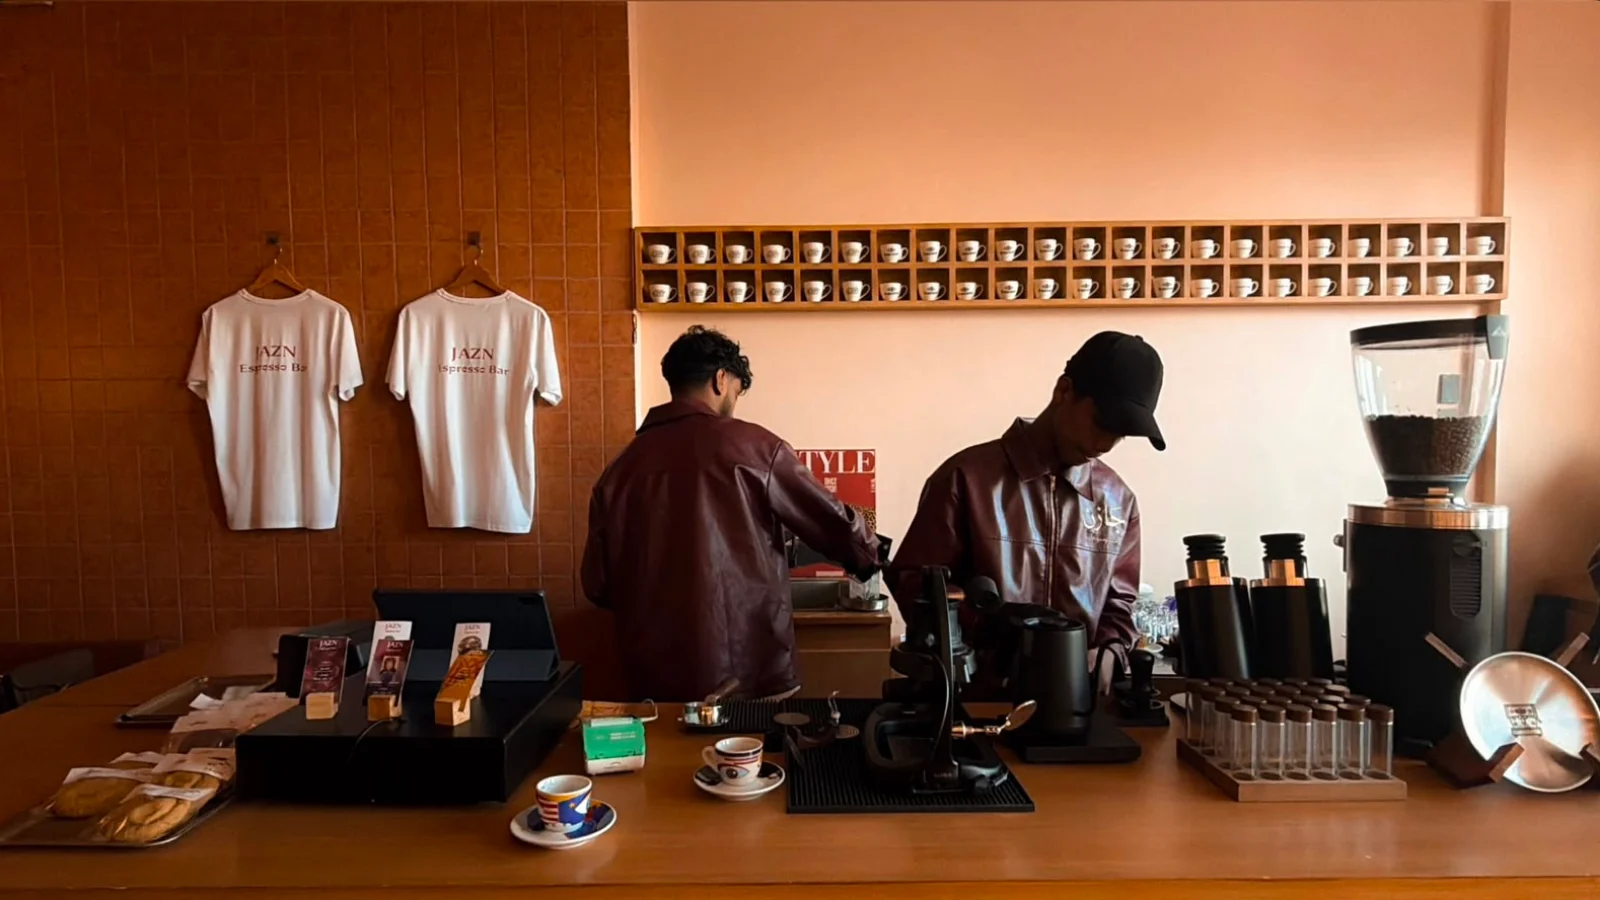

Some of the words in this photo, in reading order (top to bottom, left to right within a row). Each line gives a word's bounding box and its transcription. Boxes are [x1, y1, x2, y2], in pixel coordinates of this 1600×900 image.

[256, 345, 296, 360] JAZN
[452, 347, 494, 361] JAZN
[489, 365, 509, 375] Bar
[795, 450, 875, 474] TYLE
